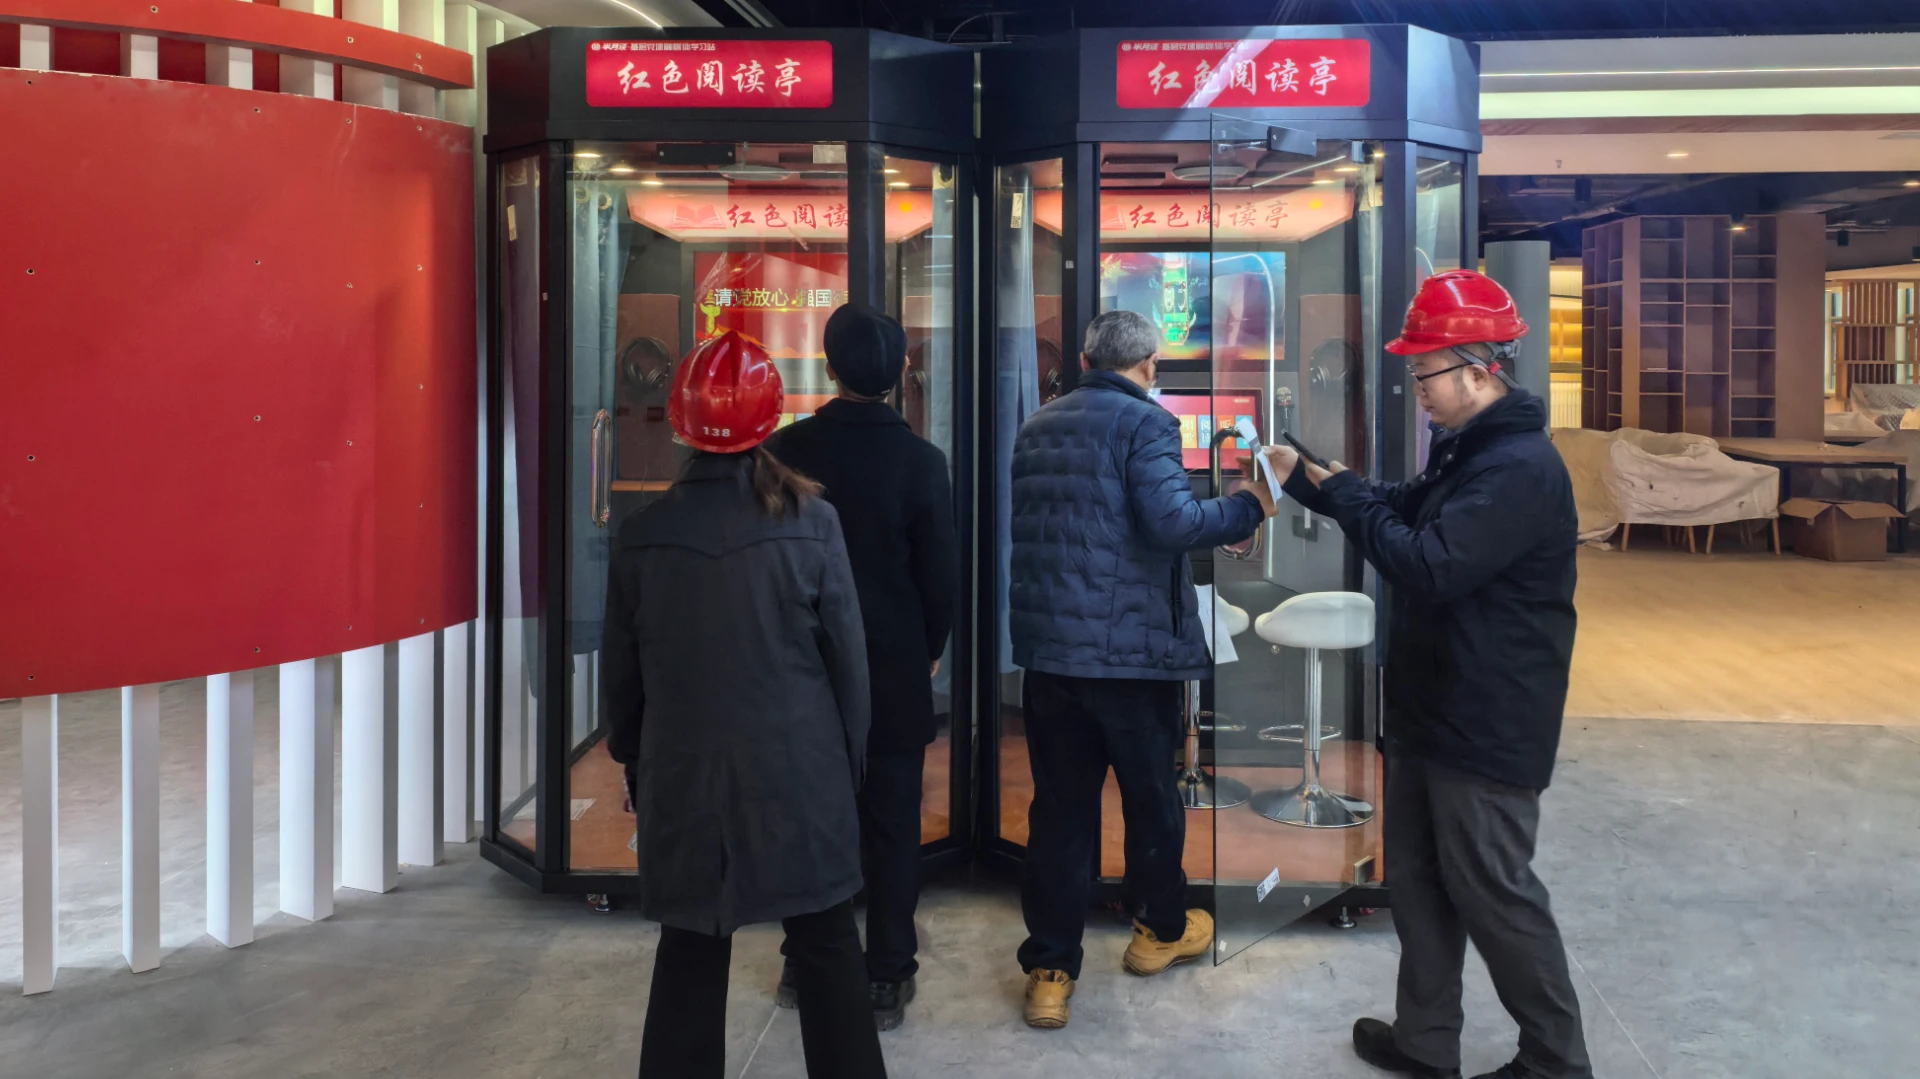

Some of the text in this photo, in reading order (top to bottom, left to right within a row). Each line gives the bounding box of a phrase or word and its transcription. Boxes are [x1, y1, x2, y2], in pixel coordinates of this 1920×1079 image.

[617, 58, 802, 97] 红色阅读亭
[1148, 56, 1337, 96] 红色阅读亭
[1129, 200, 1289, 229] 红色阅读亭
[703, 426, 731, 437] 138
